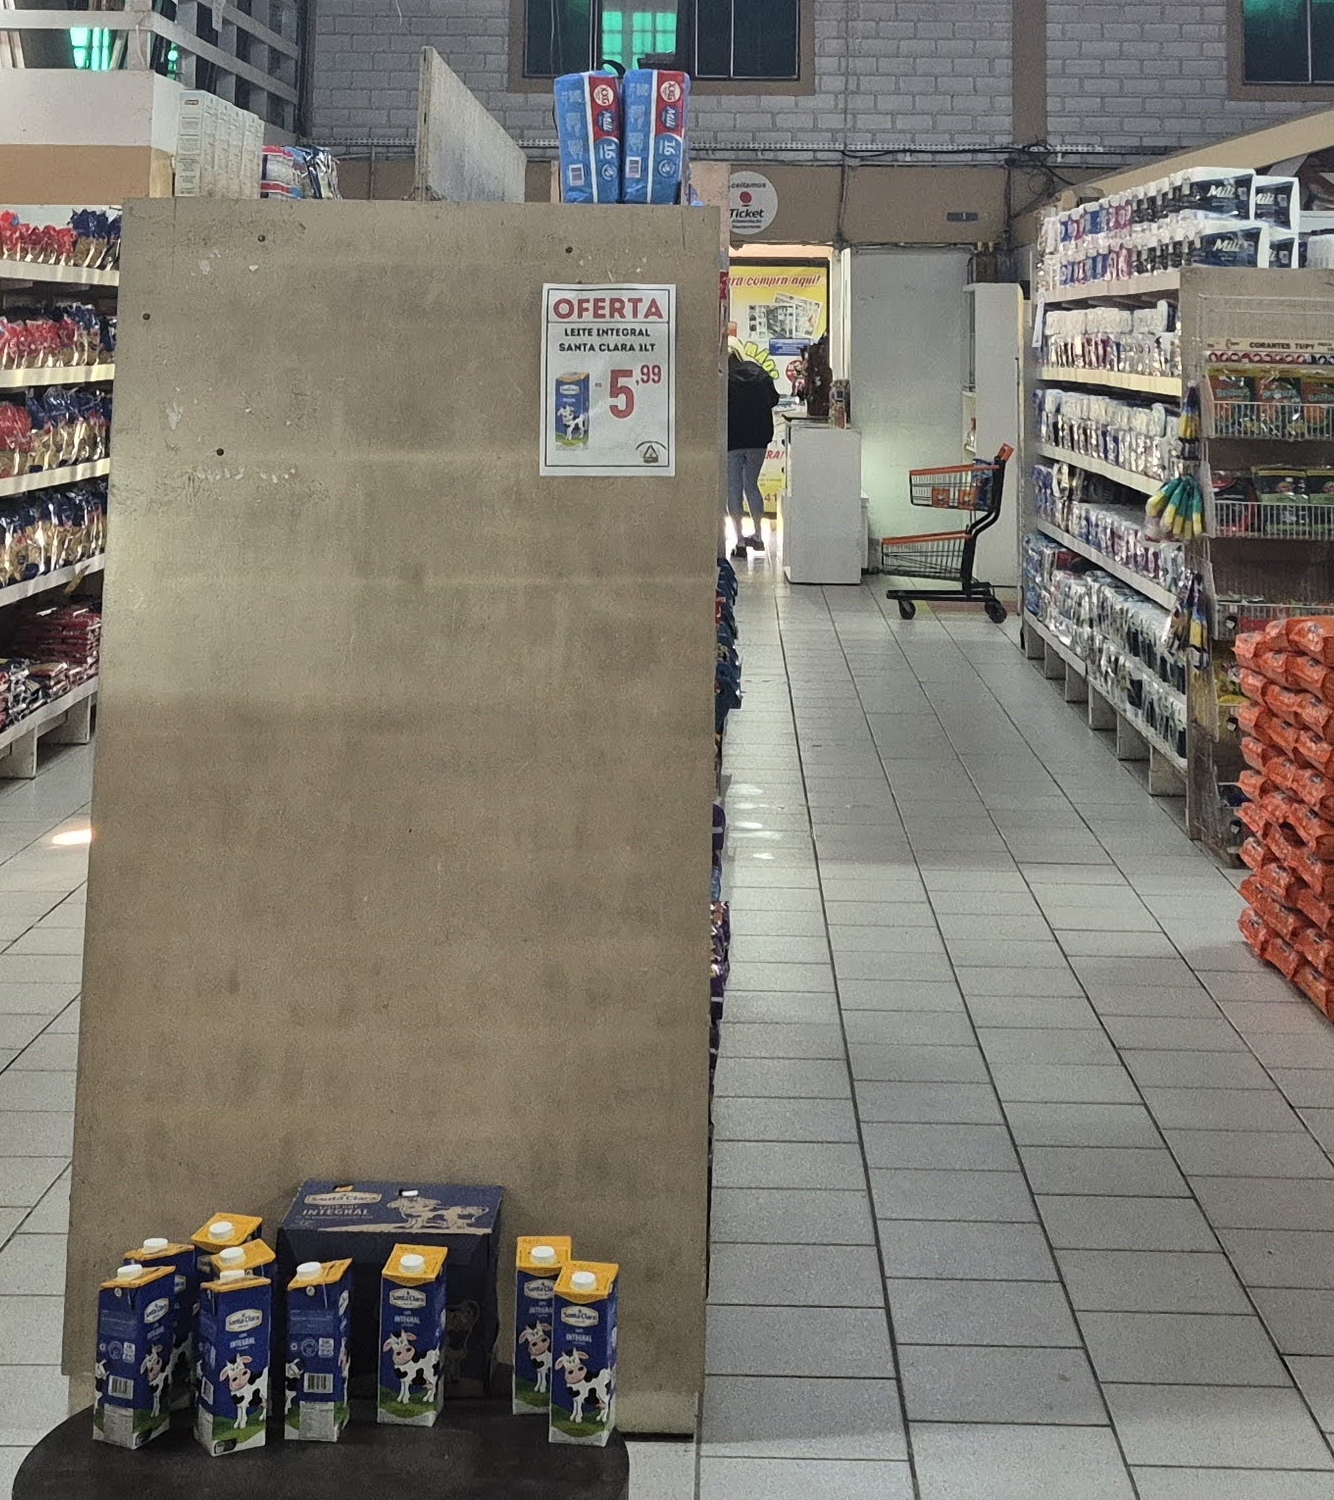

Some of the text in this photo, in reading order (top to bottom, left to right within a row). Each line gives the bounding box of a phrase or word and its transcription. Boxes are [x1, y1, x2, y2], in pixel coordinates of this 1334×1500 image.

[602, 110, 614, 132] Mili
[665, 106, 677, 128] Mili
[605, 143, 617, 159] 16
[664, 140, 676, 156] 16
[730, 181, 767, 189] ceitamos
[1207, 184, 1236, 198] Mili
[729, 208, 765, 219] Ticket
[1212, 238, 1242, 252] Mili
[745, 274, 822, 288] compra aqui!
[553, 297, 664, 320] OFERTA
[564, 327, 651, 338] LEITE INTEGRAL
[558, 343, 656, 352] SANTA CLARA 1LT
[765, 450, 785, 460] RA!
[302, 1208, 370, 1216] INTEGRAL
[543, 1284, 554, 1292] Cla
[392, 1292, 409, 1302] Santa
[563, 1311, 581, 1320] Santa
[227, 1316, 245, 1327] Santa
